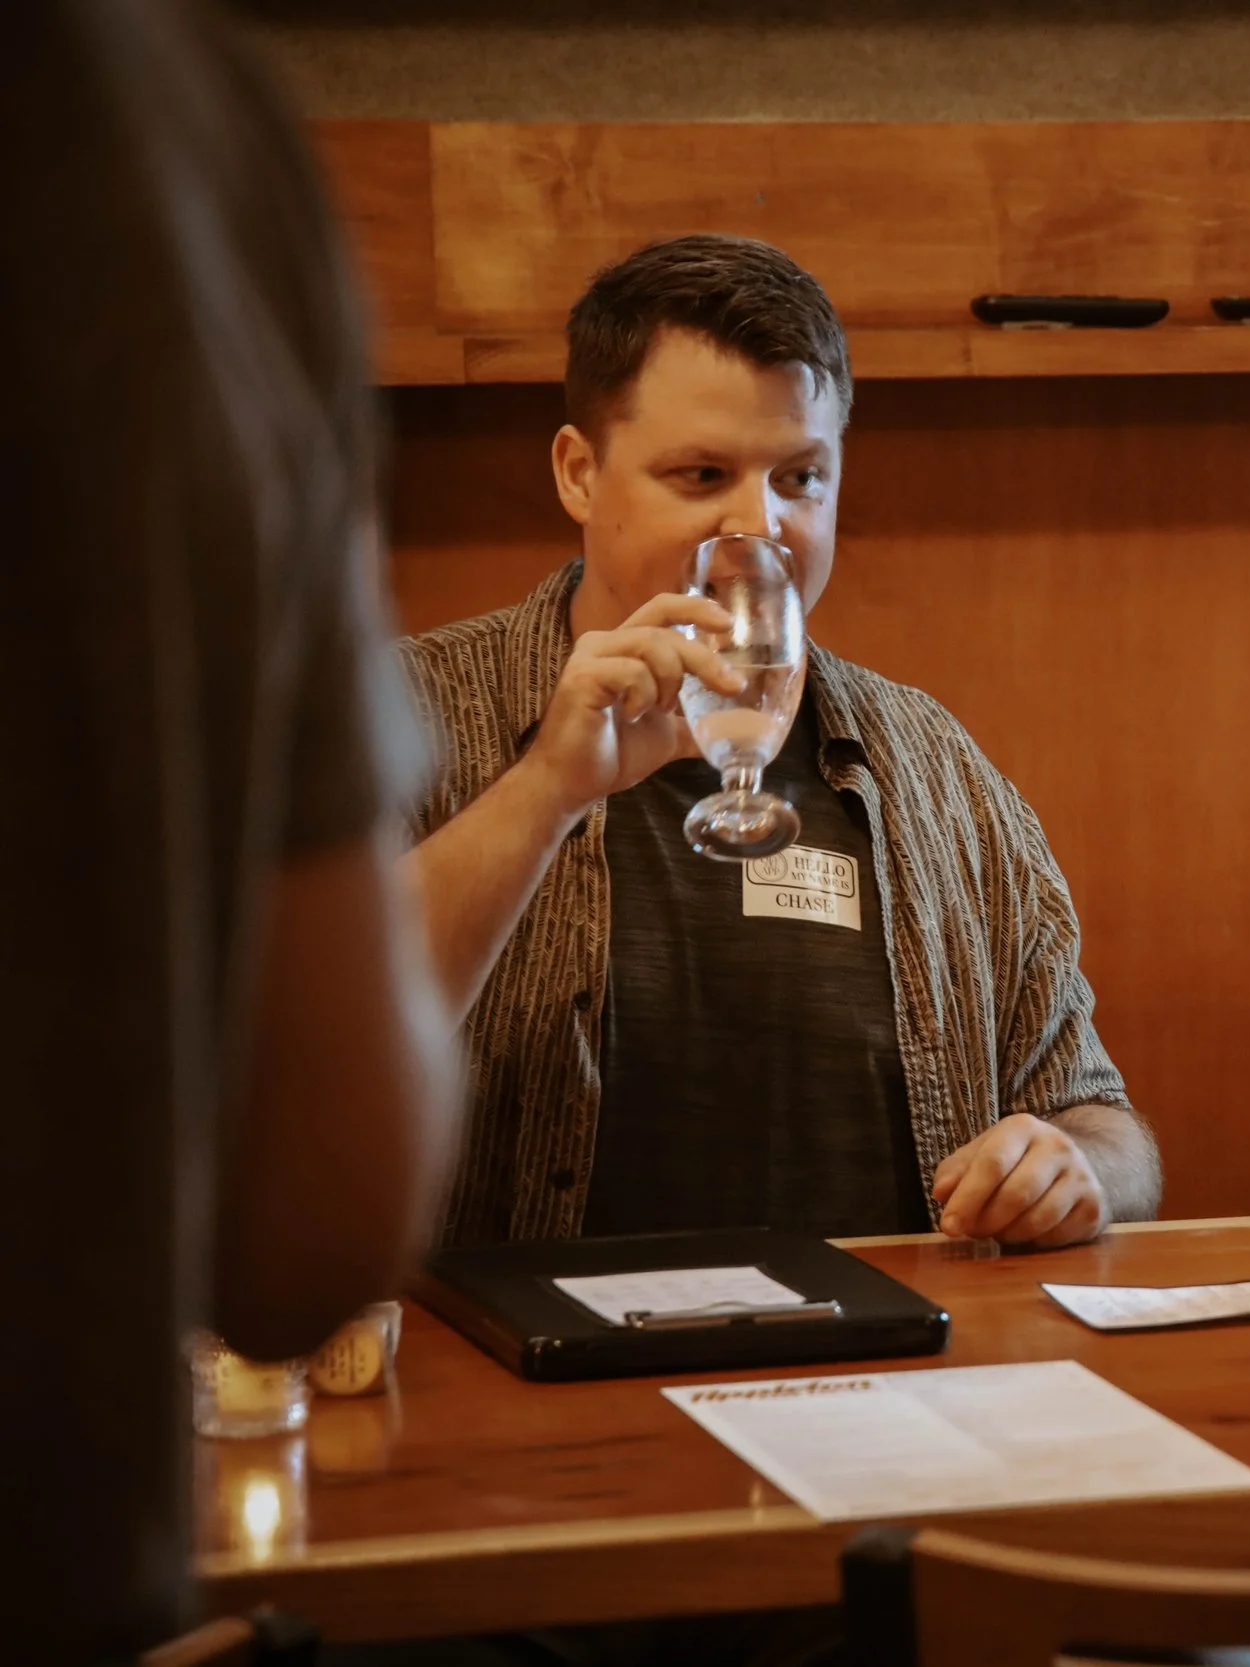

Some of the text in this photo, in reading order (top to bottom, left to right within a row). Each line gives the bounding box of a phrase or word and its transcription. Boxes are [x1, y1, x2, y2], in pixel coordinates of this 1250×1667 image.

[794, 856, 846, 877] HELLO
[791, 871, 850, 890] MY NAME IS
[775, 892, 835, 914] CHASE
